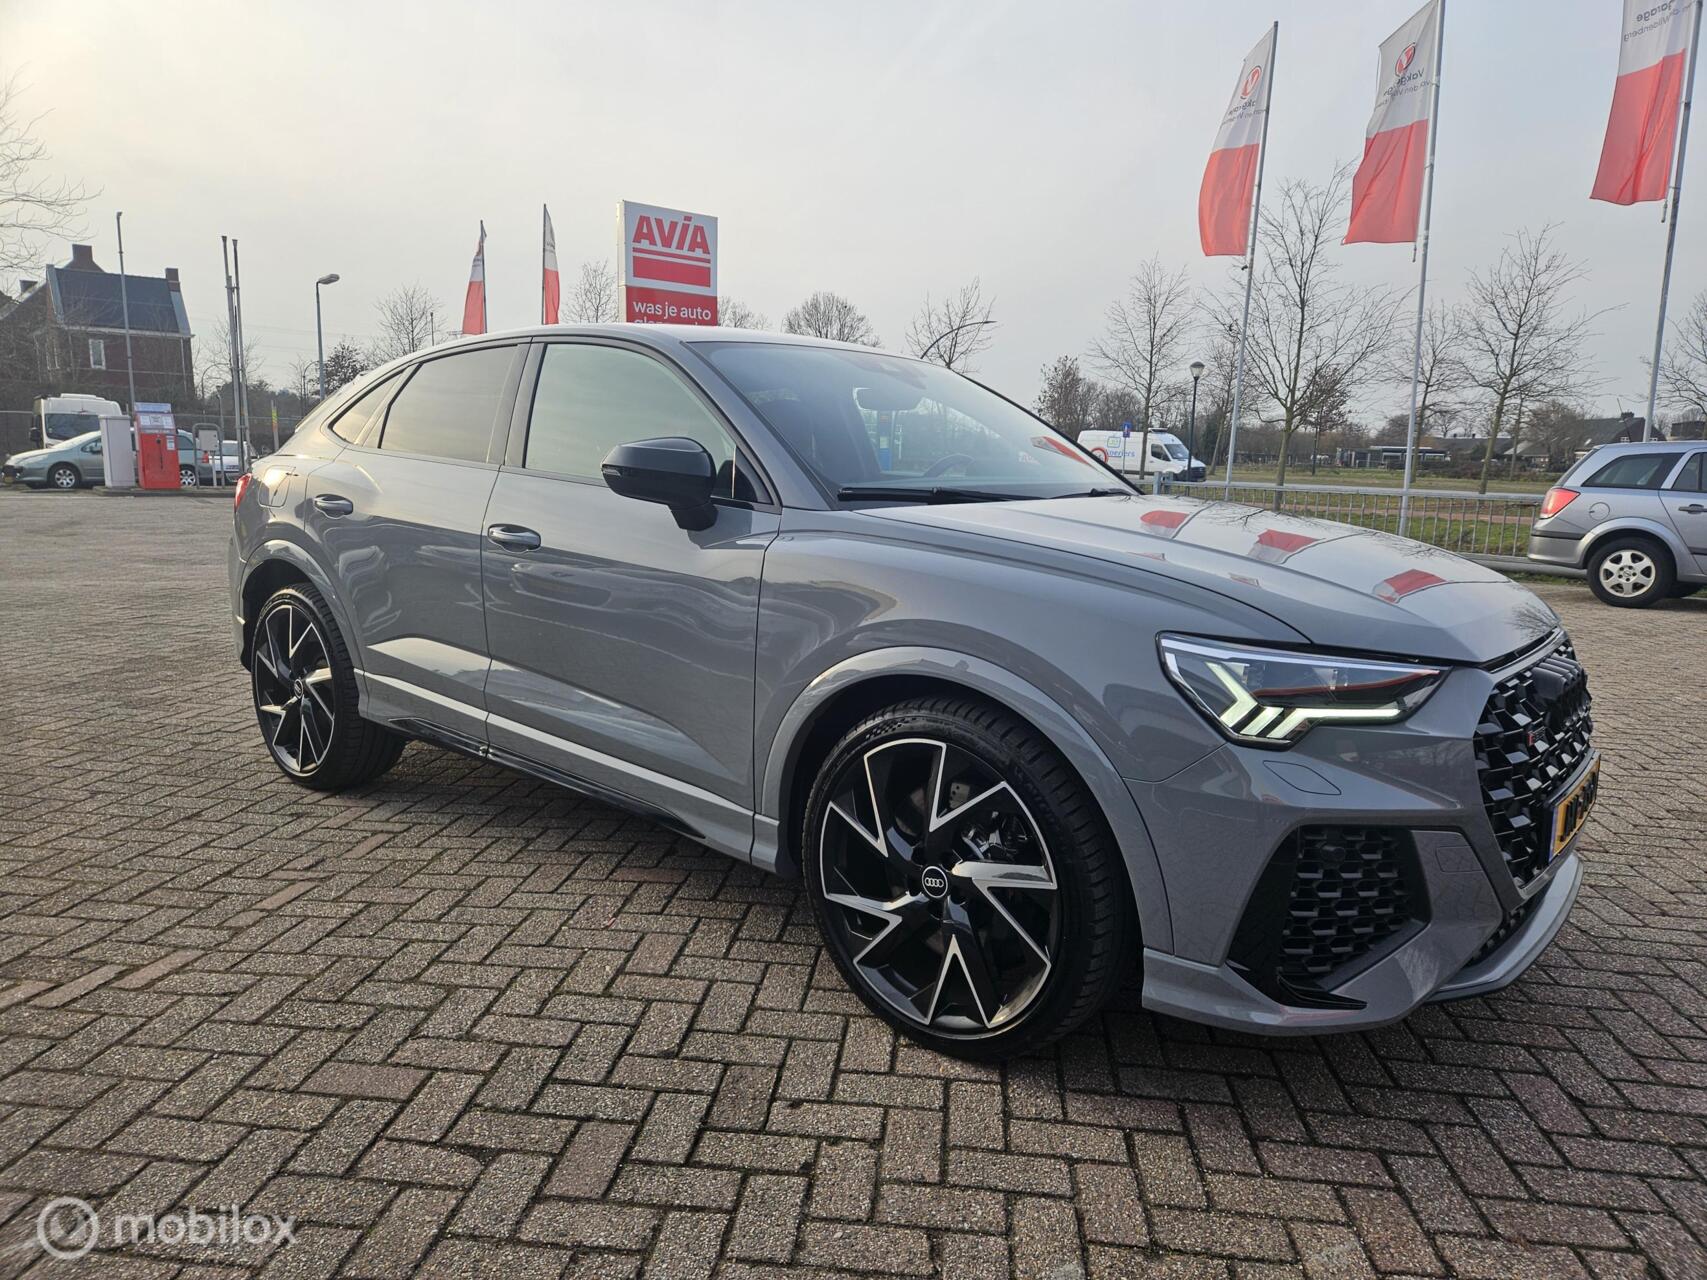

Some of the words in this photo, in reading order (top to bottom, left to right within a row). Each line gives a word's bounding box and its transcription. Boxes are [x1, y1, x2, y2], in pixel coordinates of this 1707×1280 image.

[632, 301, 662, 315] was
[664, 302, 677, 319] je
[680, 306, 711, 320] auto
